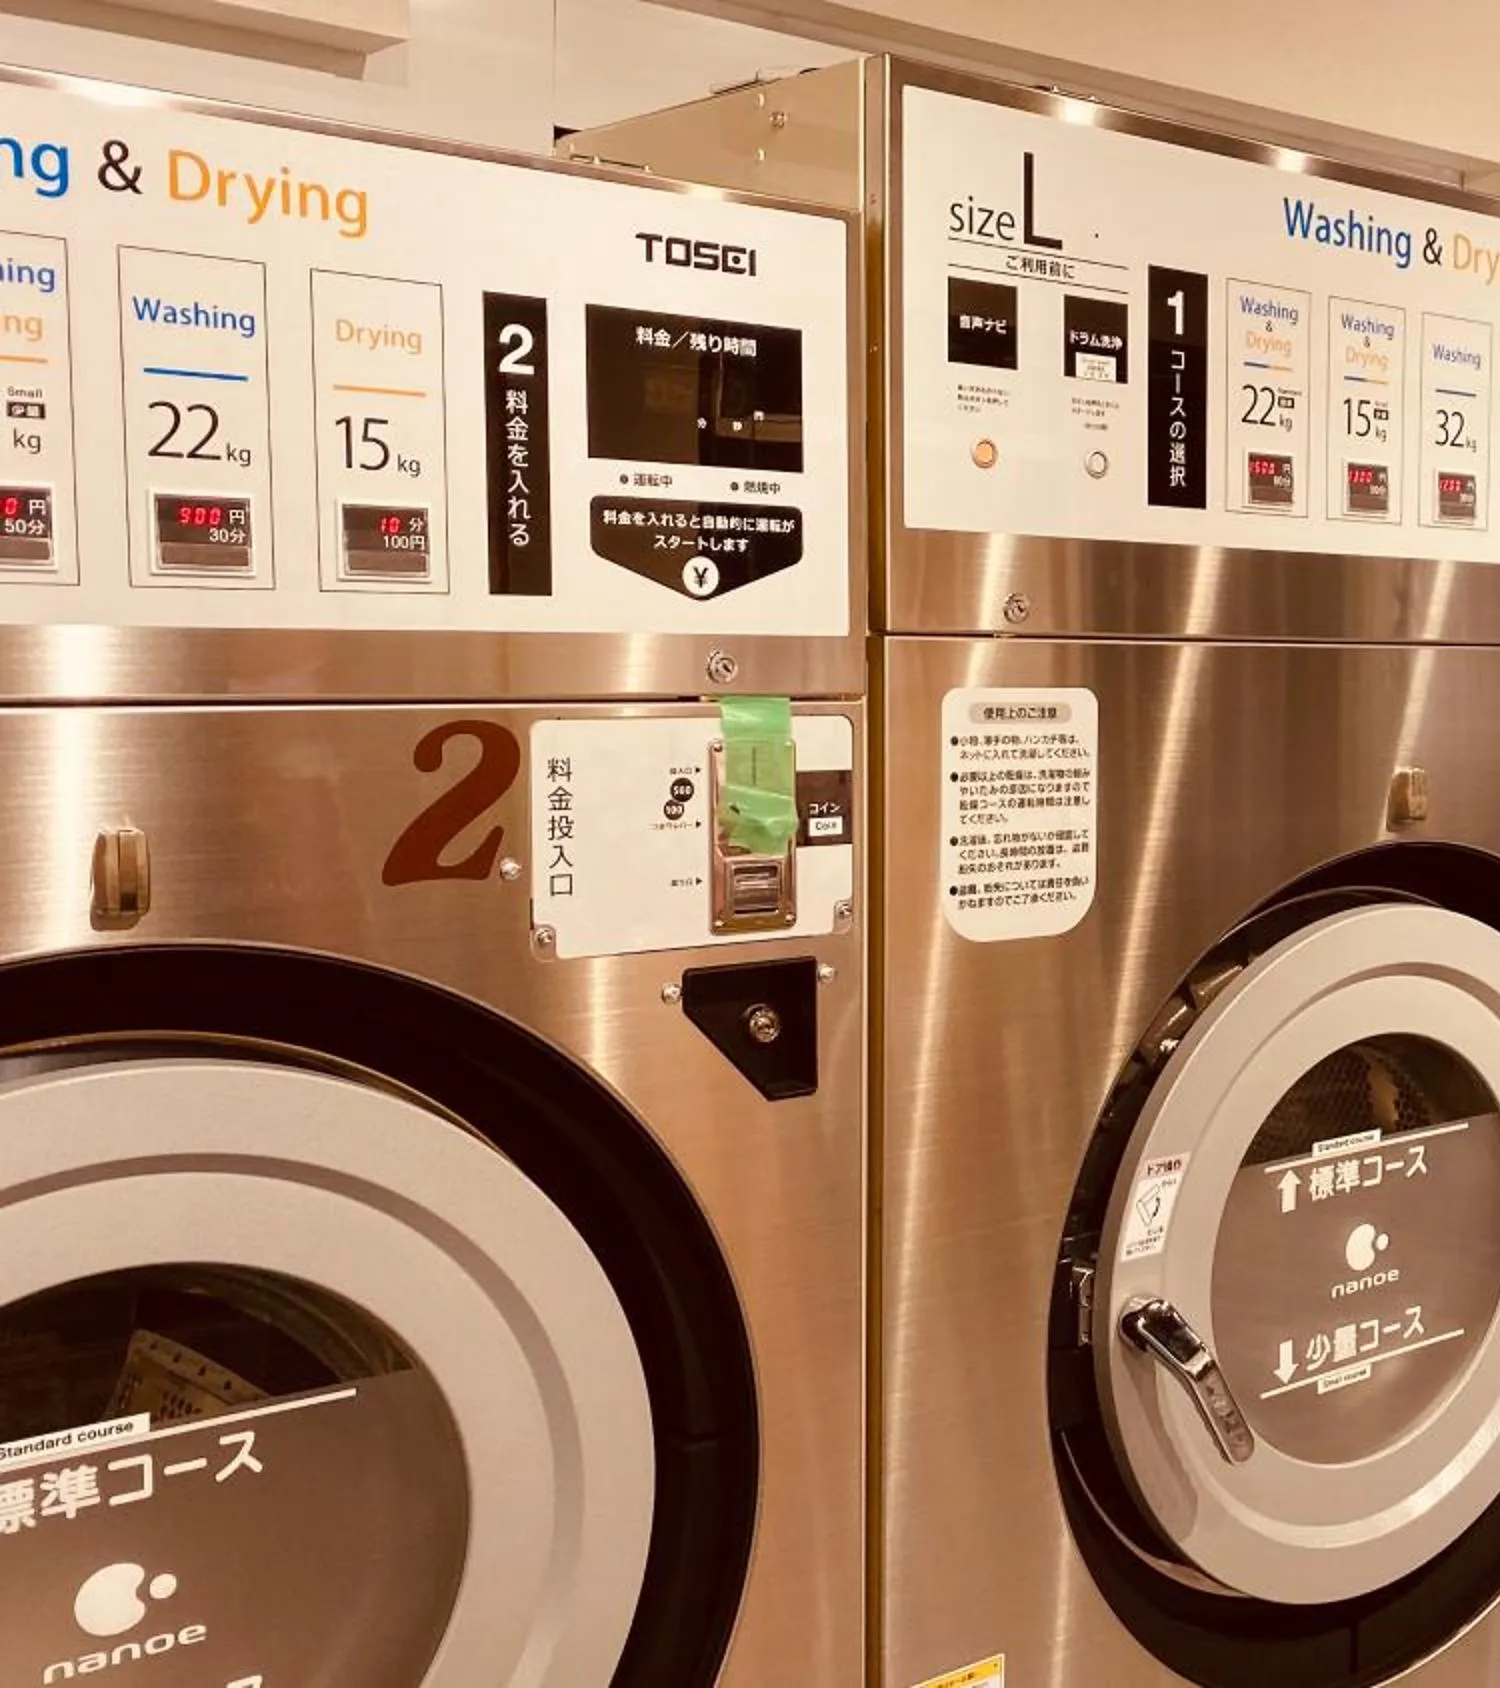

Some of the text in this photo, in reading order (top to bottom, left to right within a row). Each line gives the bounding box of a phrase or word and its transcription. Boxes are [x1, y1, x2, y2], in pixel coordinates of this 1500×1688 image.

[97, 140, 143, 194] &
[169, 148, 367, 238] Drying
[948, 152, 1063, 250] size L
[1283, 197, 1412, 269] Washing
[1422, 227, 1444, 266] &
[635, 231, 757, 277] TOSEI
[1005, 255, 1076, 279] ご利用前に
[133, 296, 256, 338] Washing
[1239, 295, 1299, 325] Washing
[336, 318, 423, 354] Drying
[1341, 312, 1395, 340] Washing
[1245, 330, 1293, 357] Drying
[1345, 345, 1390, 372] Drying
[1432, 344, 1481, 370] Washing
[1168, 349, 1187, 488] コースの選択
[13, 428, 41, 454] kg
[505, 389, 532, 548] 料金を入れる
[209, 528, 246, 544] 30分
[602, 509, 796, 534] 料金を入れると自動的に運転が
[383, 534, 425, 550] 100円
[653, 535, 750, 553] スタートします
[381, 719, 521, 888] 2
[808, 801, 841, 815] コイン
[546, 757, 575, 897] 料金投入口
[1309, 1145, 1427, 1202] 標準コース
[1331, 1268, 1399, 1299] nanoe
[1306, 1305, 1425, 1371] 少量コース
[77, 1421, 134, 1446] course
[43, 1624, 208, 1685] nanoe
